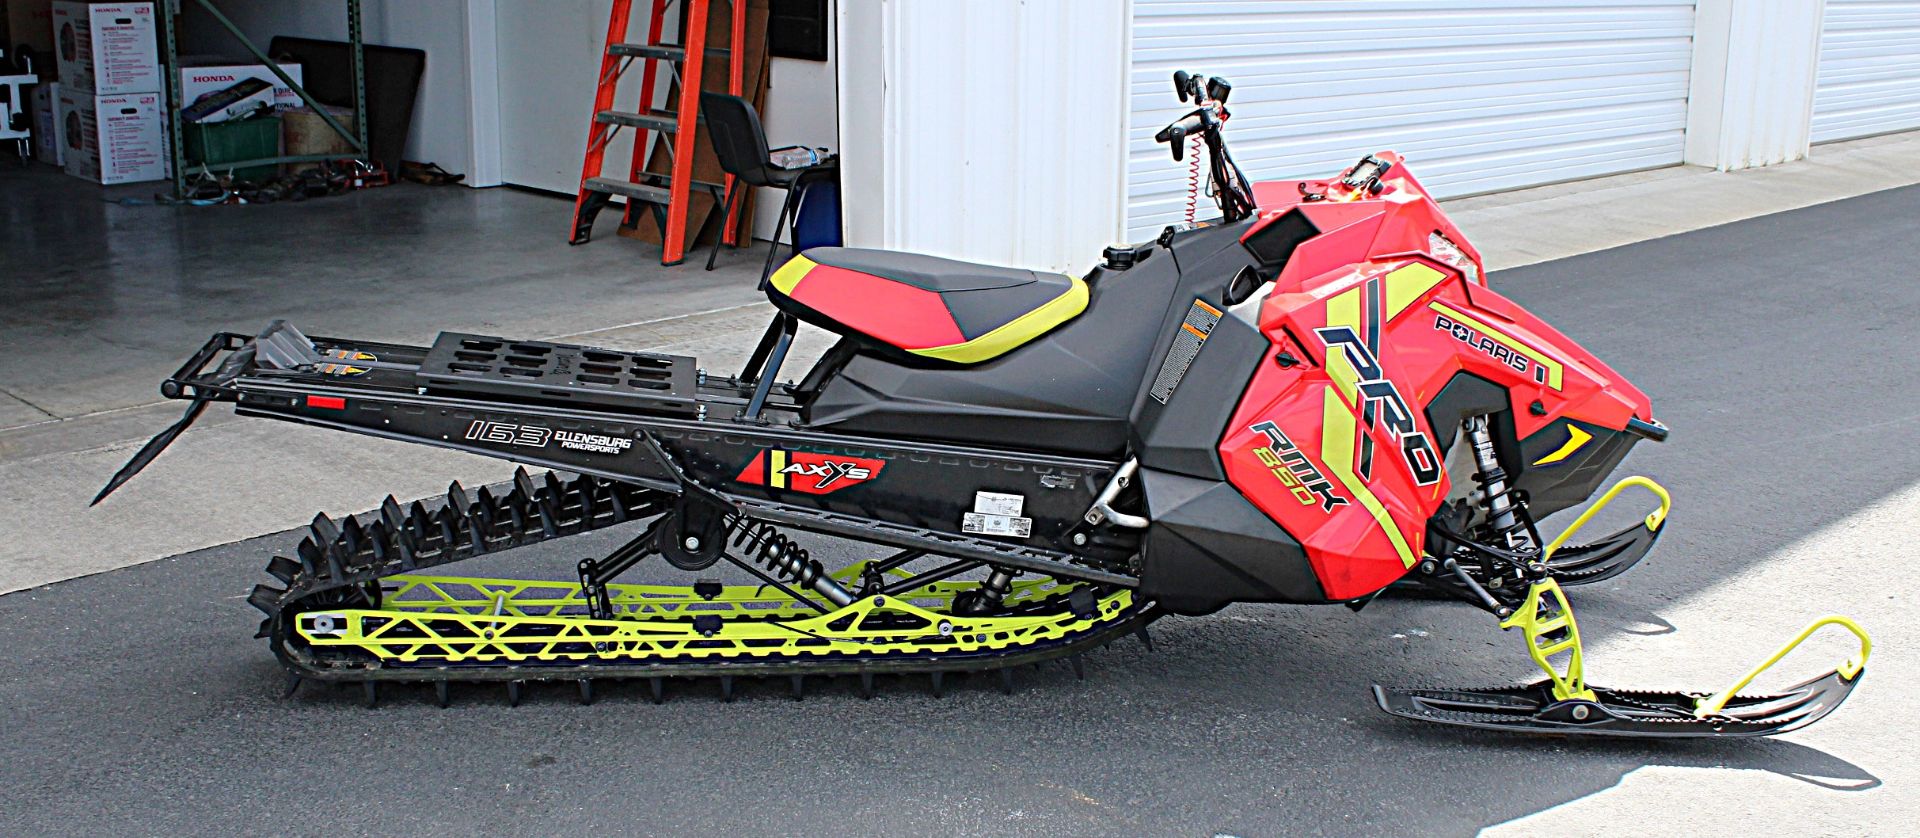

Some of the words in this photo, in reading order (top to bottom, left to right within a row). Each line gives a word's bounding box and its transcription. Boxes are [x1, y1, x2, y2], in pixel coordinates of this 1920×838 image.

[1434, 314, 1528, 372] POLARIS
[1313, 325, 1441, 487] PRO
[466, 420, 552, 447] 163
[555, 431, 632, 449] ELLENSBURG
[562, 441, 620, 455] POWERSPORTS
[779, 460, 870, 488] AXYS
[1249, 421, 1350, 514] RMK
[1252, 447, 1317, 506] 850
